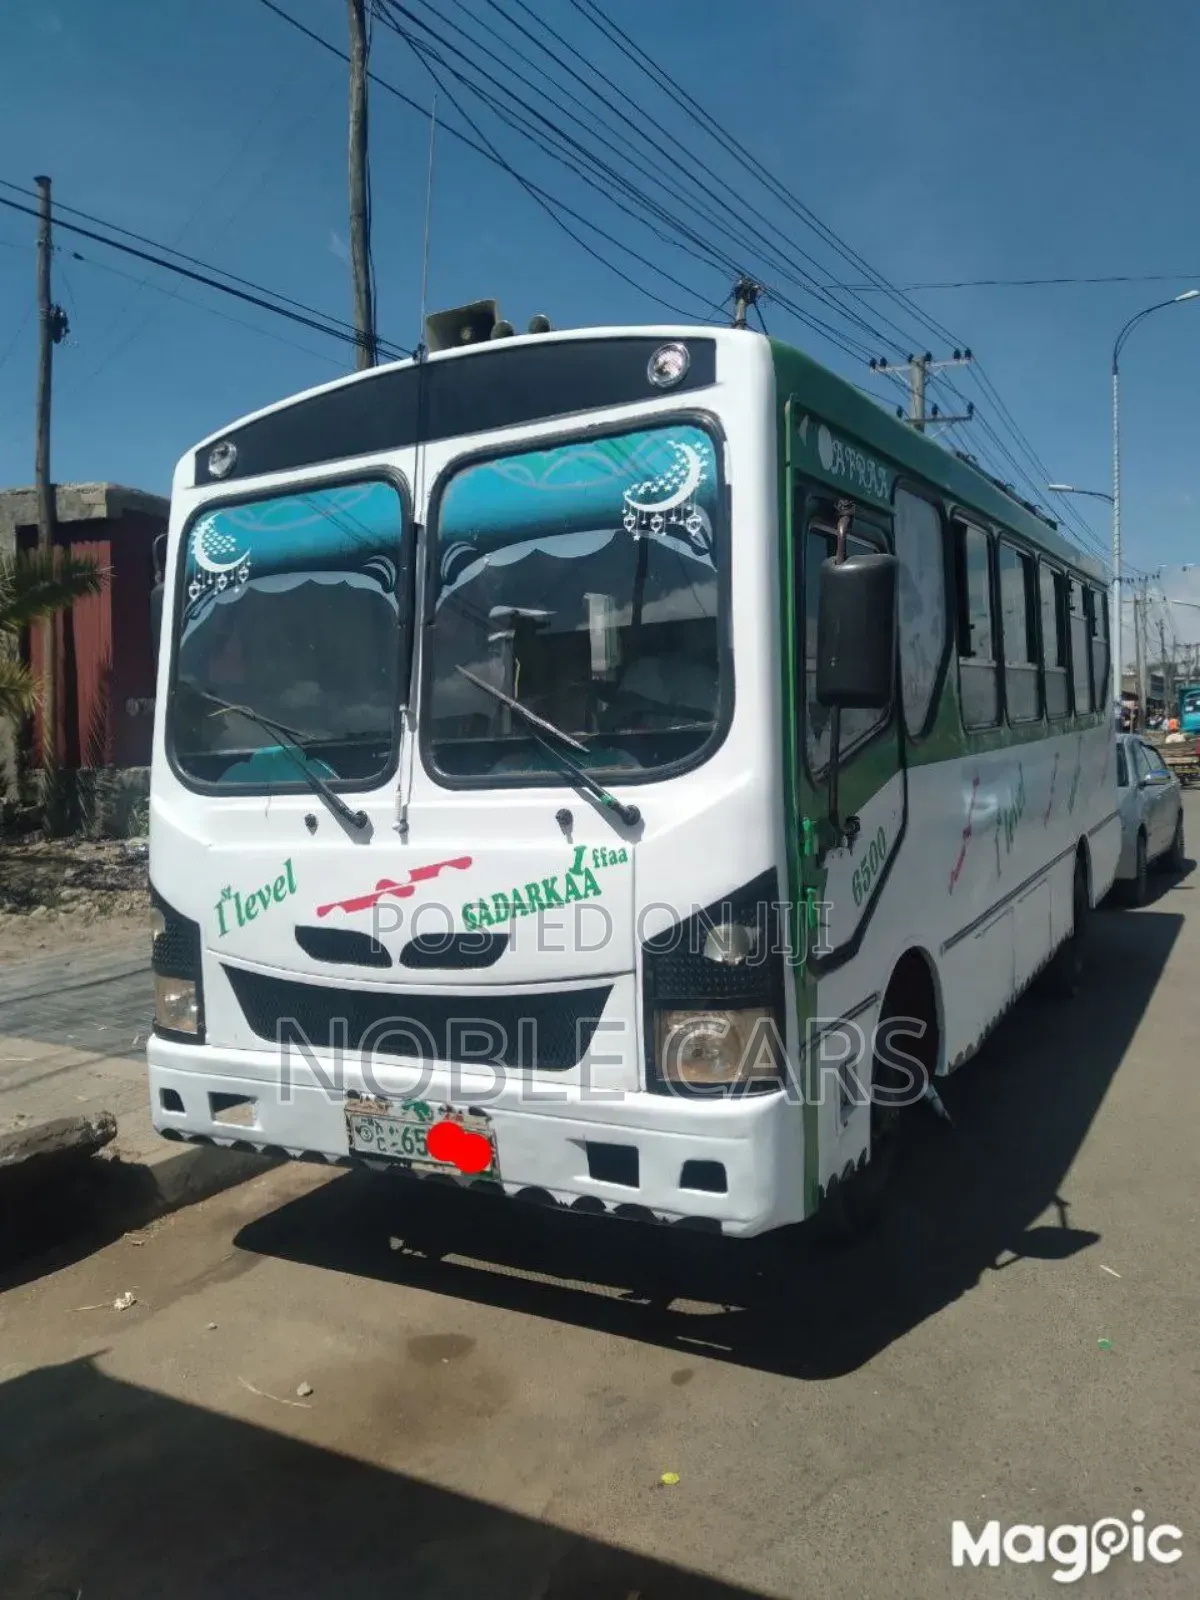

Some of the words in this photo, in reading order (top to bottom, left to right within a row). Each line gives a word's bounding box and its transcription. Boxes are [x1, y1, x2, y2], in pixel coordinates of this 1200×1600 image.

[233, 856, 297, 928] level
[462, 867, 602, 931] SADARKAA
[852, 826, 886, 908] 6500
